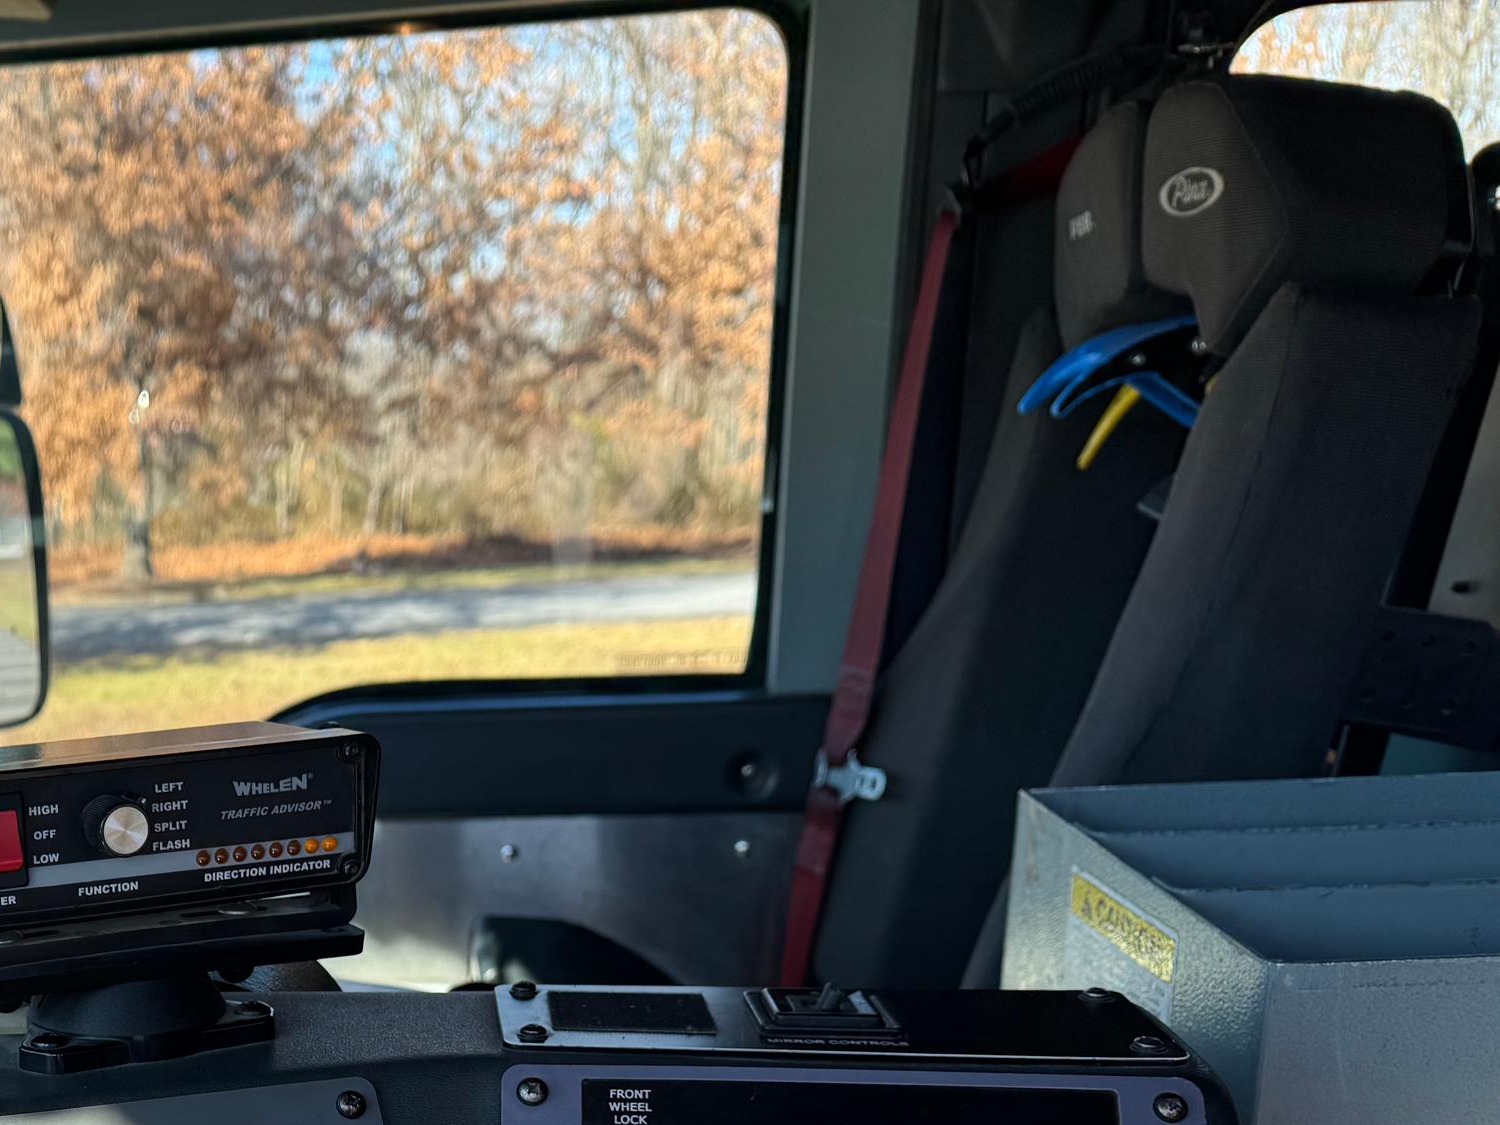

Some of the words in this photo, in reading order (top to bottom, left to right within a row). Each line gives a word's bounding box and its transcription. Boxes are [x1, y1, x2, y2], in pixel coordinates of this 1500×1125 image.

[155, 782, 183, 793] LEFT
[233, 773, 308, 797] WHELEN
[29, 804, 58, 816] HIGH
[152, 800, 188, 813] RIGHT
[220, 805, 268, 820] TRAFFIC
[154, 820, 187, 833] SPLIT
[34, 829, 56, 840] OFF
[153, 839, 190, 851] FLASH
[33, 853, 59, 865] LOW
[204, 866, 267, 882] DIRECTION
[270, 859, 330, 875] INDICATOR
[78, 881, 138, 897] FUNCTION
[610, 1090, 651, 1099] FRONT
[609, 1103, 652, 1112] WHEEL
[614, 1115, 647, 1125] LOCK
